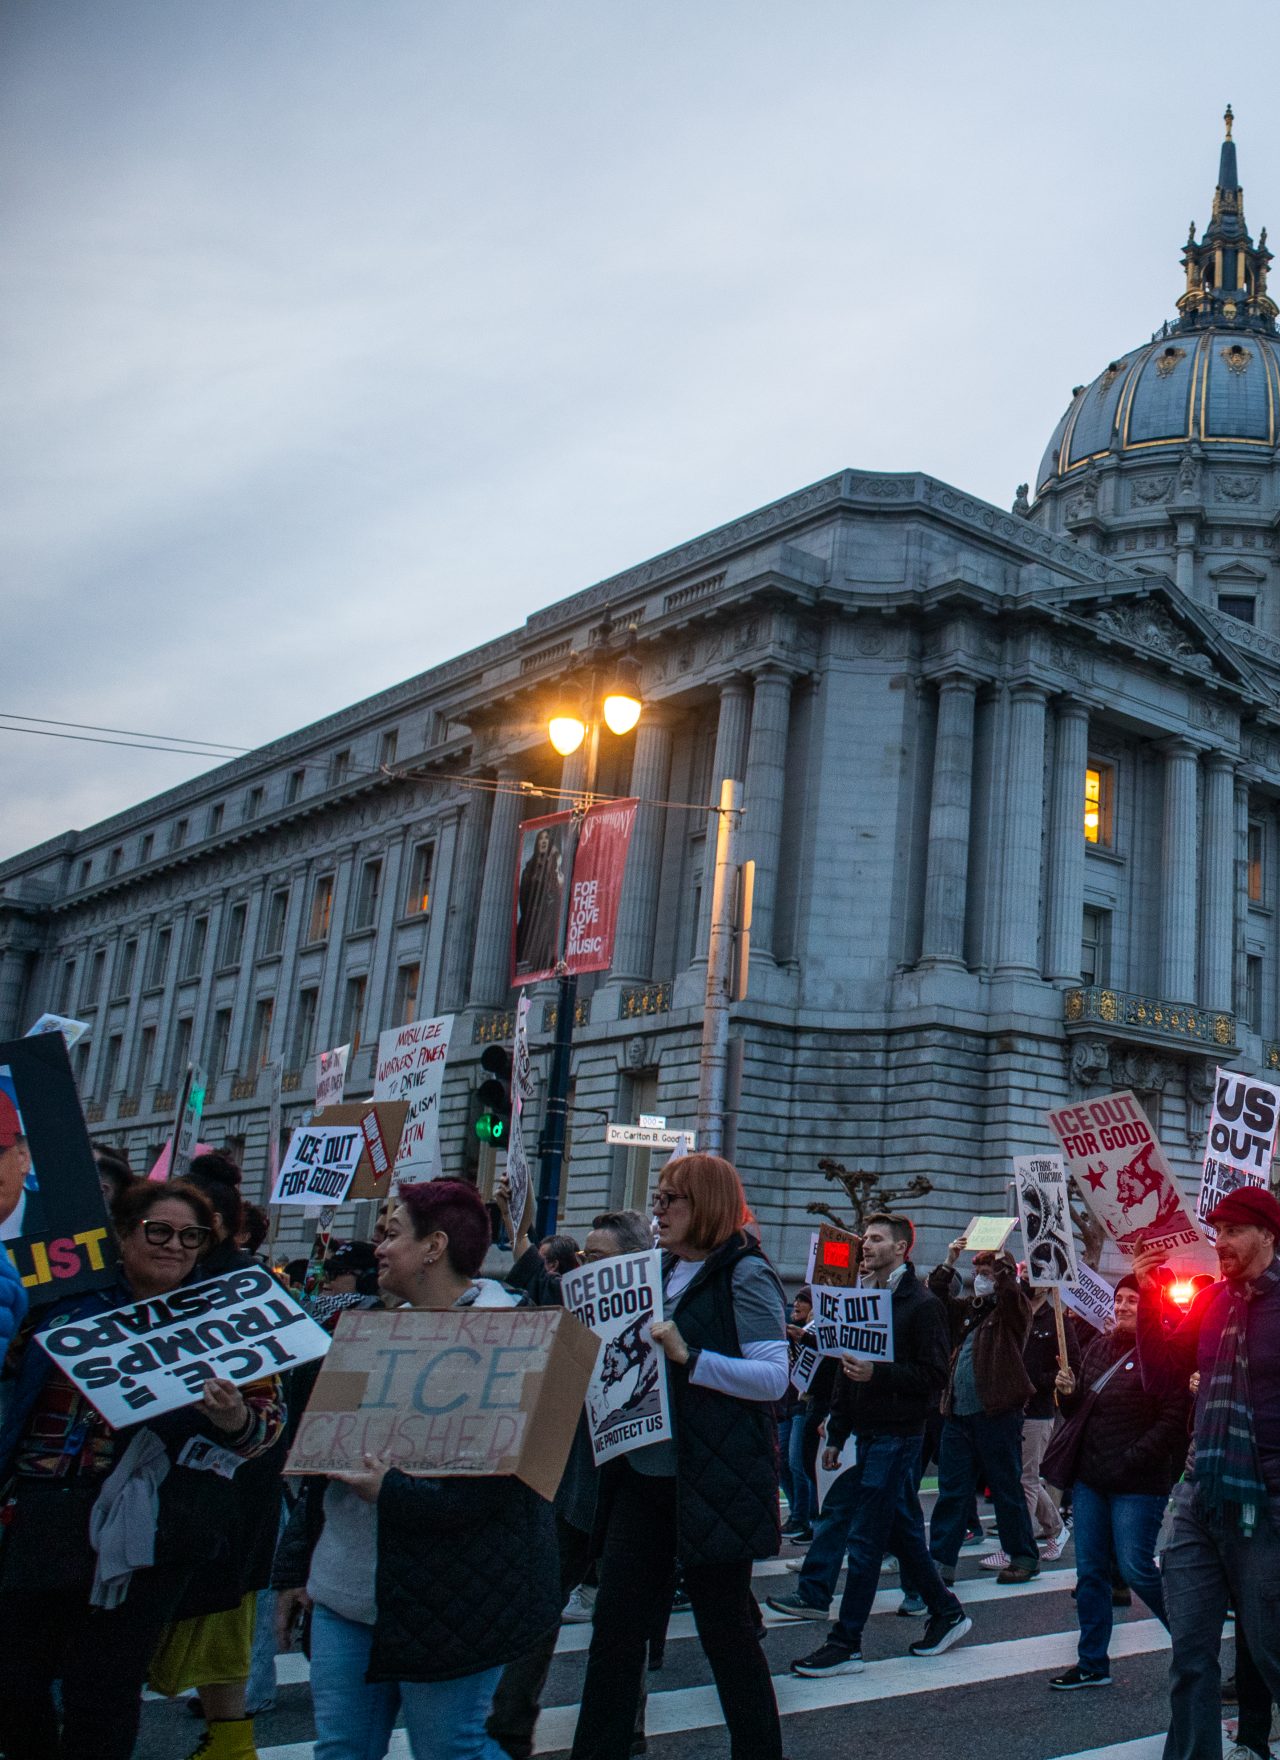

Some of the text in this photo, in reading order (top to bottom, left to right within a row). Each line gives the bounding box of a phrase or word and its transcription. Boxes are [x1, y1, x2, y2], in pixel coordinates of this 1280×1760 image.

[595, 806, 637, 839] SYMPHONY
[574, 880, 598, 897] FOR
[574, 896, 597, 912] THE
[570, 926, 586, 942] OF
[571, 908, 600, 927] LOVE
[568, 936, 602, 956] MUSIC
[395, 1022, 445, 1051] MOBILIZE
[417, 1043, 447, 1068] POWER
[400, 1068, 429, 1093] DRIVE
[1050, 1096, 1138, 1136] ICE OUT
[1217, 1077, 1276, 1133] US
[295, 1134, 323, 1166] ICE
[322, 1133, 358, 1165] OUT
[611, 1130, 691, 1145] Dr. Carlton B. Goodtt
[1062, 1120, 1150, 1159] FOR GOOD
[1211, 1123, 1271, 1167] OUT
[279, 1166, 350, 1199] FOR GOOD!
[1204, 1157, 1217, 1186] OF
[1179, 1231, 1199, 1245] US
[565, 1256, 650, 1309] ICE OUT
[46, 1270, 273, 1357] GESTAPO
[599, 1285, 653, 1322] GOOD
[820, 1291, 881, 1323] ICE OUT
[1093, 1304, 1112, 1321] OUT
[72, 1300, 308, 1390] TRUMP'S
[335, 1311, 560, 1347] I LIKE MY
[818, 1325, 839, 1350] FOR
[839, 1324, 888, 1356] GOOD!
[357, 1345, 541, 1416] ICE
[299, 1412, 518, 1460] CRUSHED
[594, 1415, 664, 1454] WE PROTECT US
